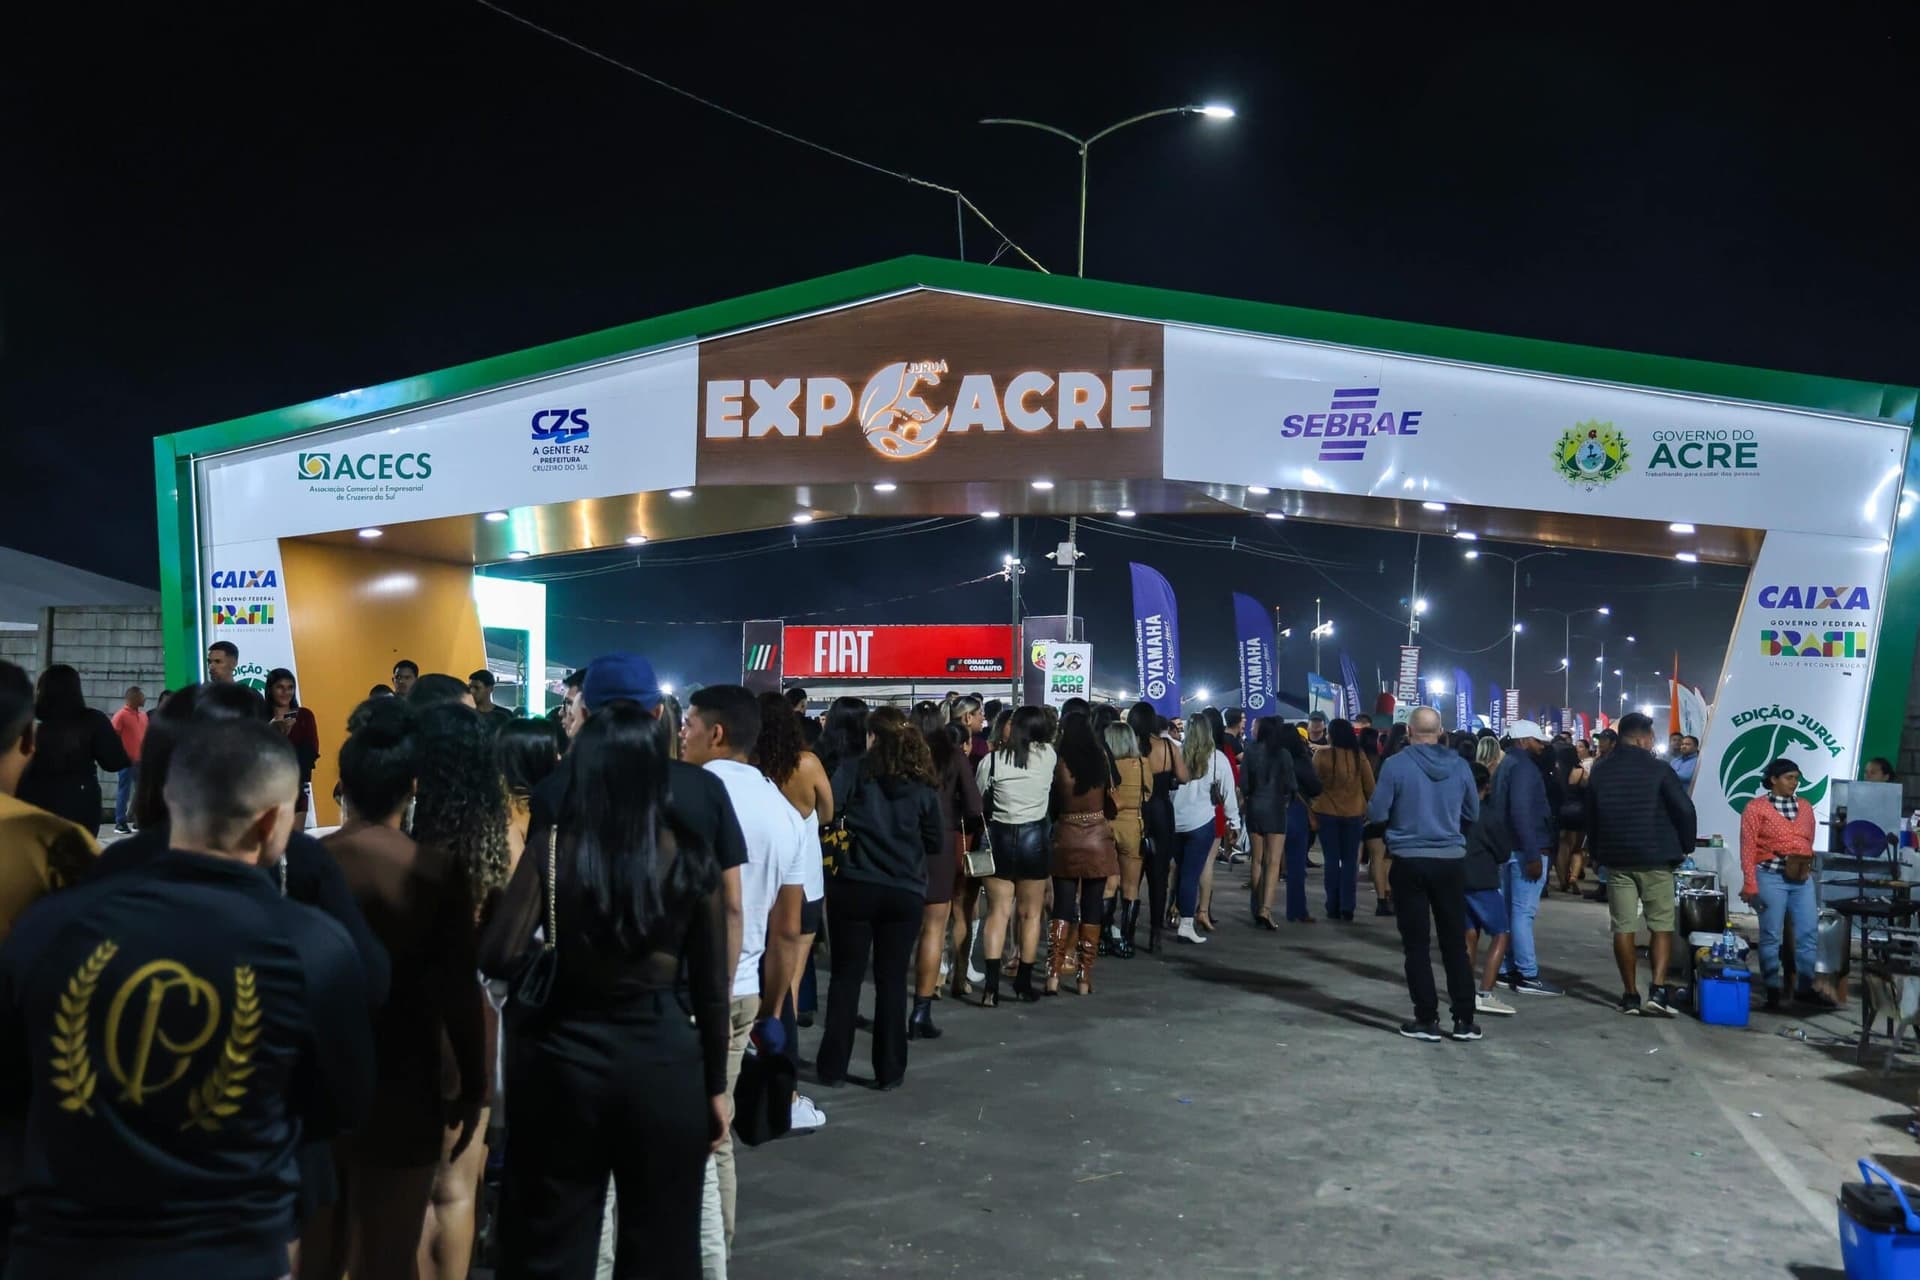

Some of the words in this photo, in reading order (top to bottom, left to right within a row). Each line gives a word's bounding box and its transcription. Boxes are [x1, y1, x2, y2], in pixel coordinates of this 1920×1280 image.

[532, 408, 589, 435] CZS
[1281, 411, 1422, 437] SEBRAE
[1653, 430, 1727, 441] GOVERNO
[1732, 430, 1754, 440] DO
[533, 446, 539, 455] A
[542, 445, 571, 455] GENTE
[574, 445, 590, 454] FAZ
[1648, 442, 1758, 469] ACRE
[333, 452, 432, 480] ACECS
[386, 484, 424, 493] Empresarial
[211, 570, 276, 588] CAIXA
[1758, 586, 1870, 609] CAIXA
[213, 604, 274, 625] BRASIL
[814, 630, 874, 673] FIAT
[1145, 614, 1164, 680] YAMAHA
[1761, 630, 1867, 658] BRASIL
[233, 663, 262, 677] DIÇÃO
[1247, 637, 1263, 693] YAMAHA
[1399, 648, 1419, 699] BRAHMA
[1051, 674, 1084, 683] EXPO
[1051, 684, 1083, 693] ACRE
[1731, 704, 1795, 728] EDIÇÃO
[1797, 714, 1845, 758] JURUÁ
